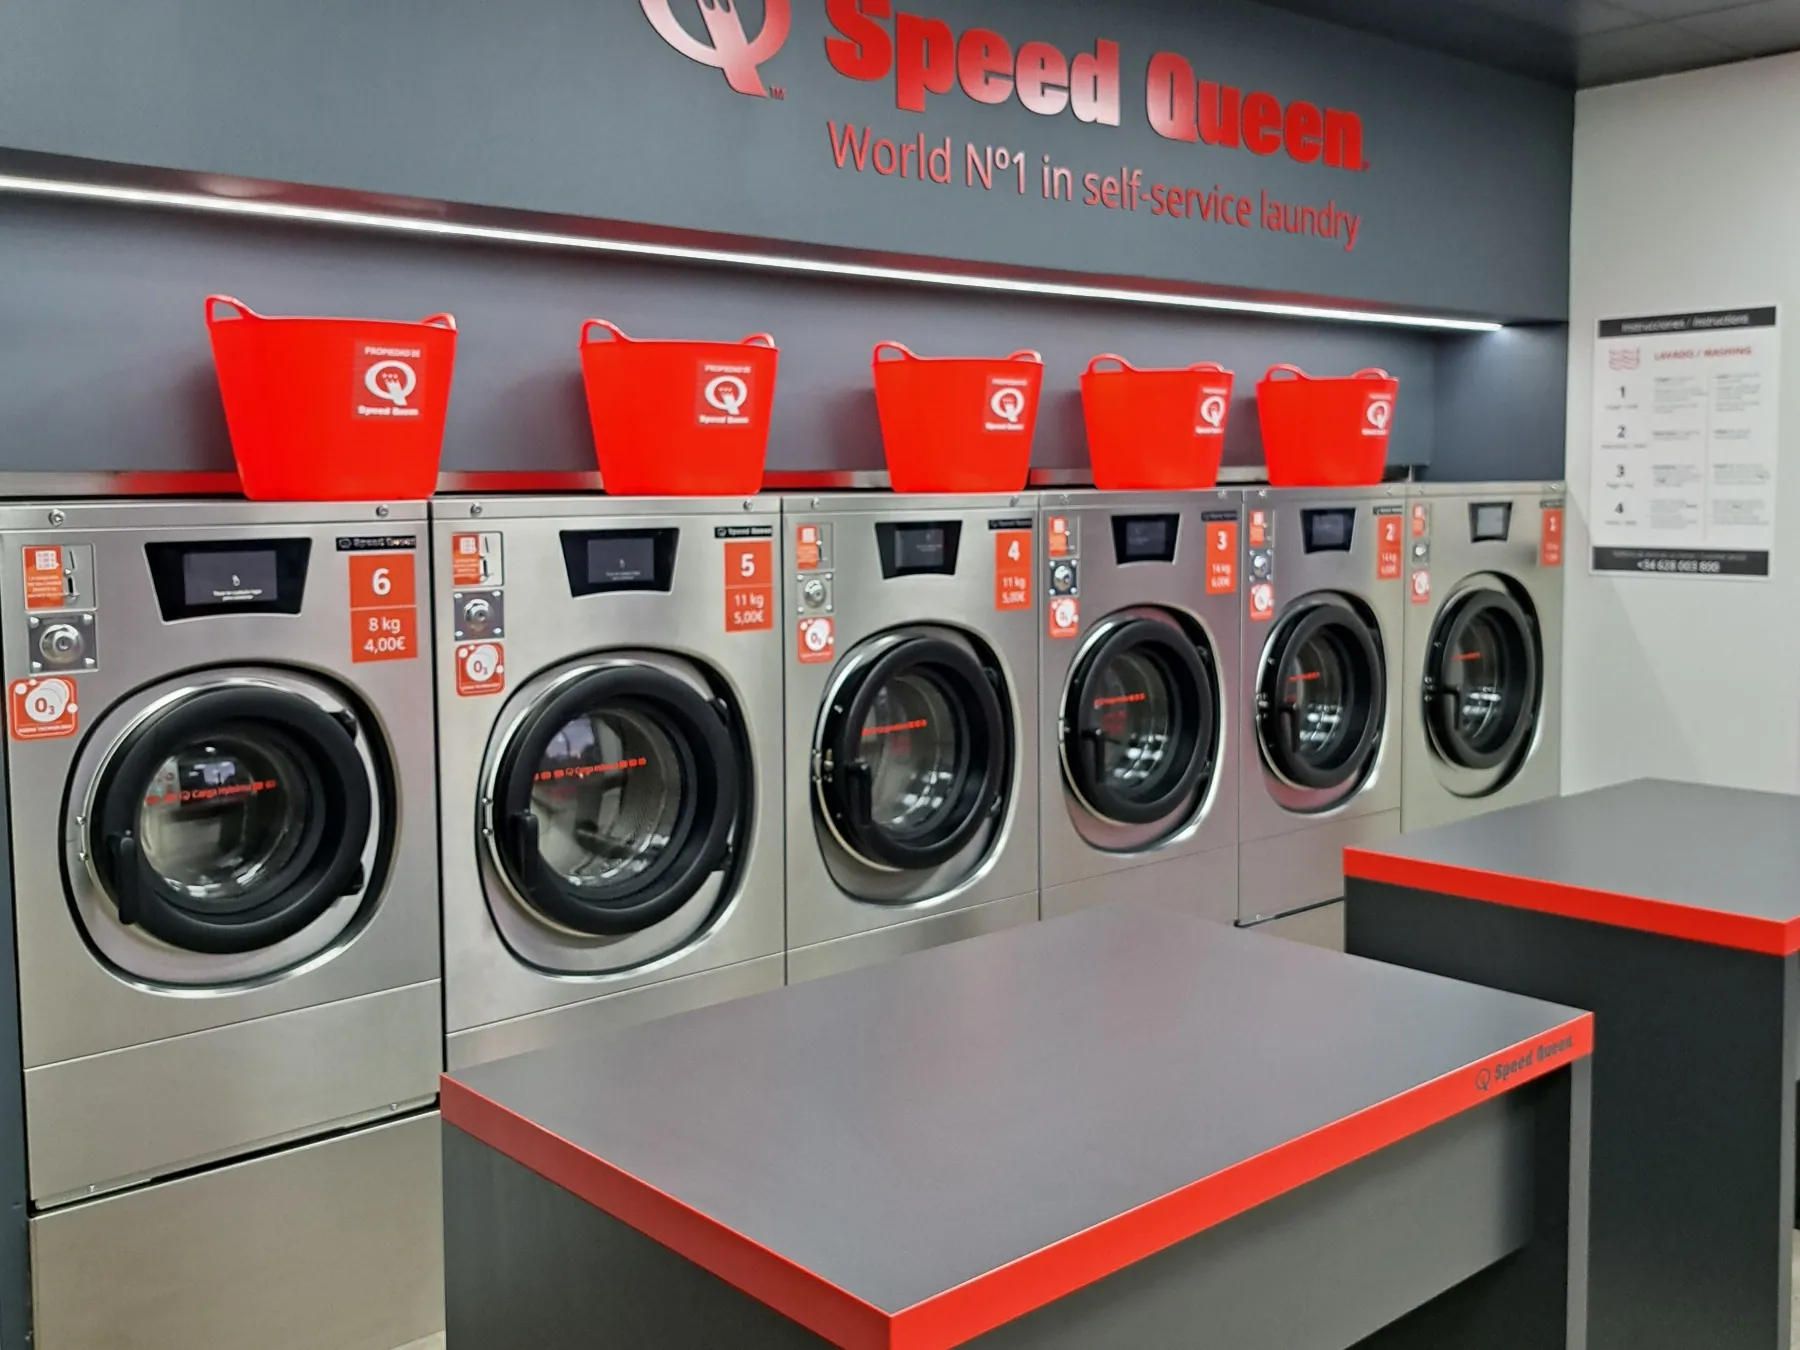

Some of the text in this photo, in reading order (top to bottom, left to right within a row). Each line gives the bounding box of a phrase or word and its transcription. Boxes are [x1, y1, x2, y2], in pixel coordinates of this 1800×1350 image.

[825, 0, 1364, 172] Speed Queen
[827, 120, 951, 184] World
[1042, 154, 1074, 201] in
[1083, 166, 1254, 229] self-service
[1261, 188, 1361, 252] laundry
[1617, 385, 1626, 399] 1
[1616, 425, 1626, 438] 2
[1615, 464, 1625, 478] 3
[1614, 502, 1624, 514] 4
[1217, 530, 1228, 551] 3
[1385, 523, 1396, 542] 2
[1008, 540, 1021, 562] 4
[740, 553, 755, 577] 5
[372, 567, 392, 596] 6
[734, 592, 765, 608] 11 kg
[368, 616, 401, 634] 8 kg
[364, 636, 407, 654] 4,00€
[1494, 1050, 1533, 1081] Speed
[1536, 1036, 1573, 1062] Queen
